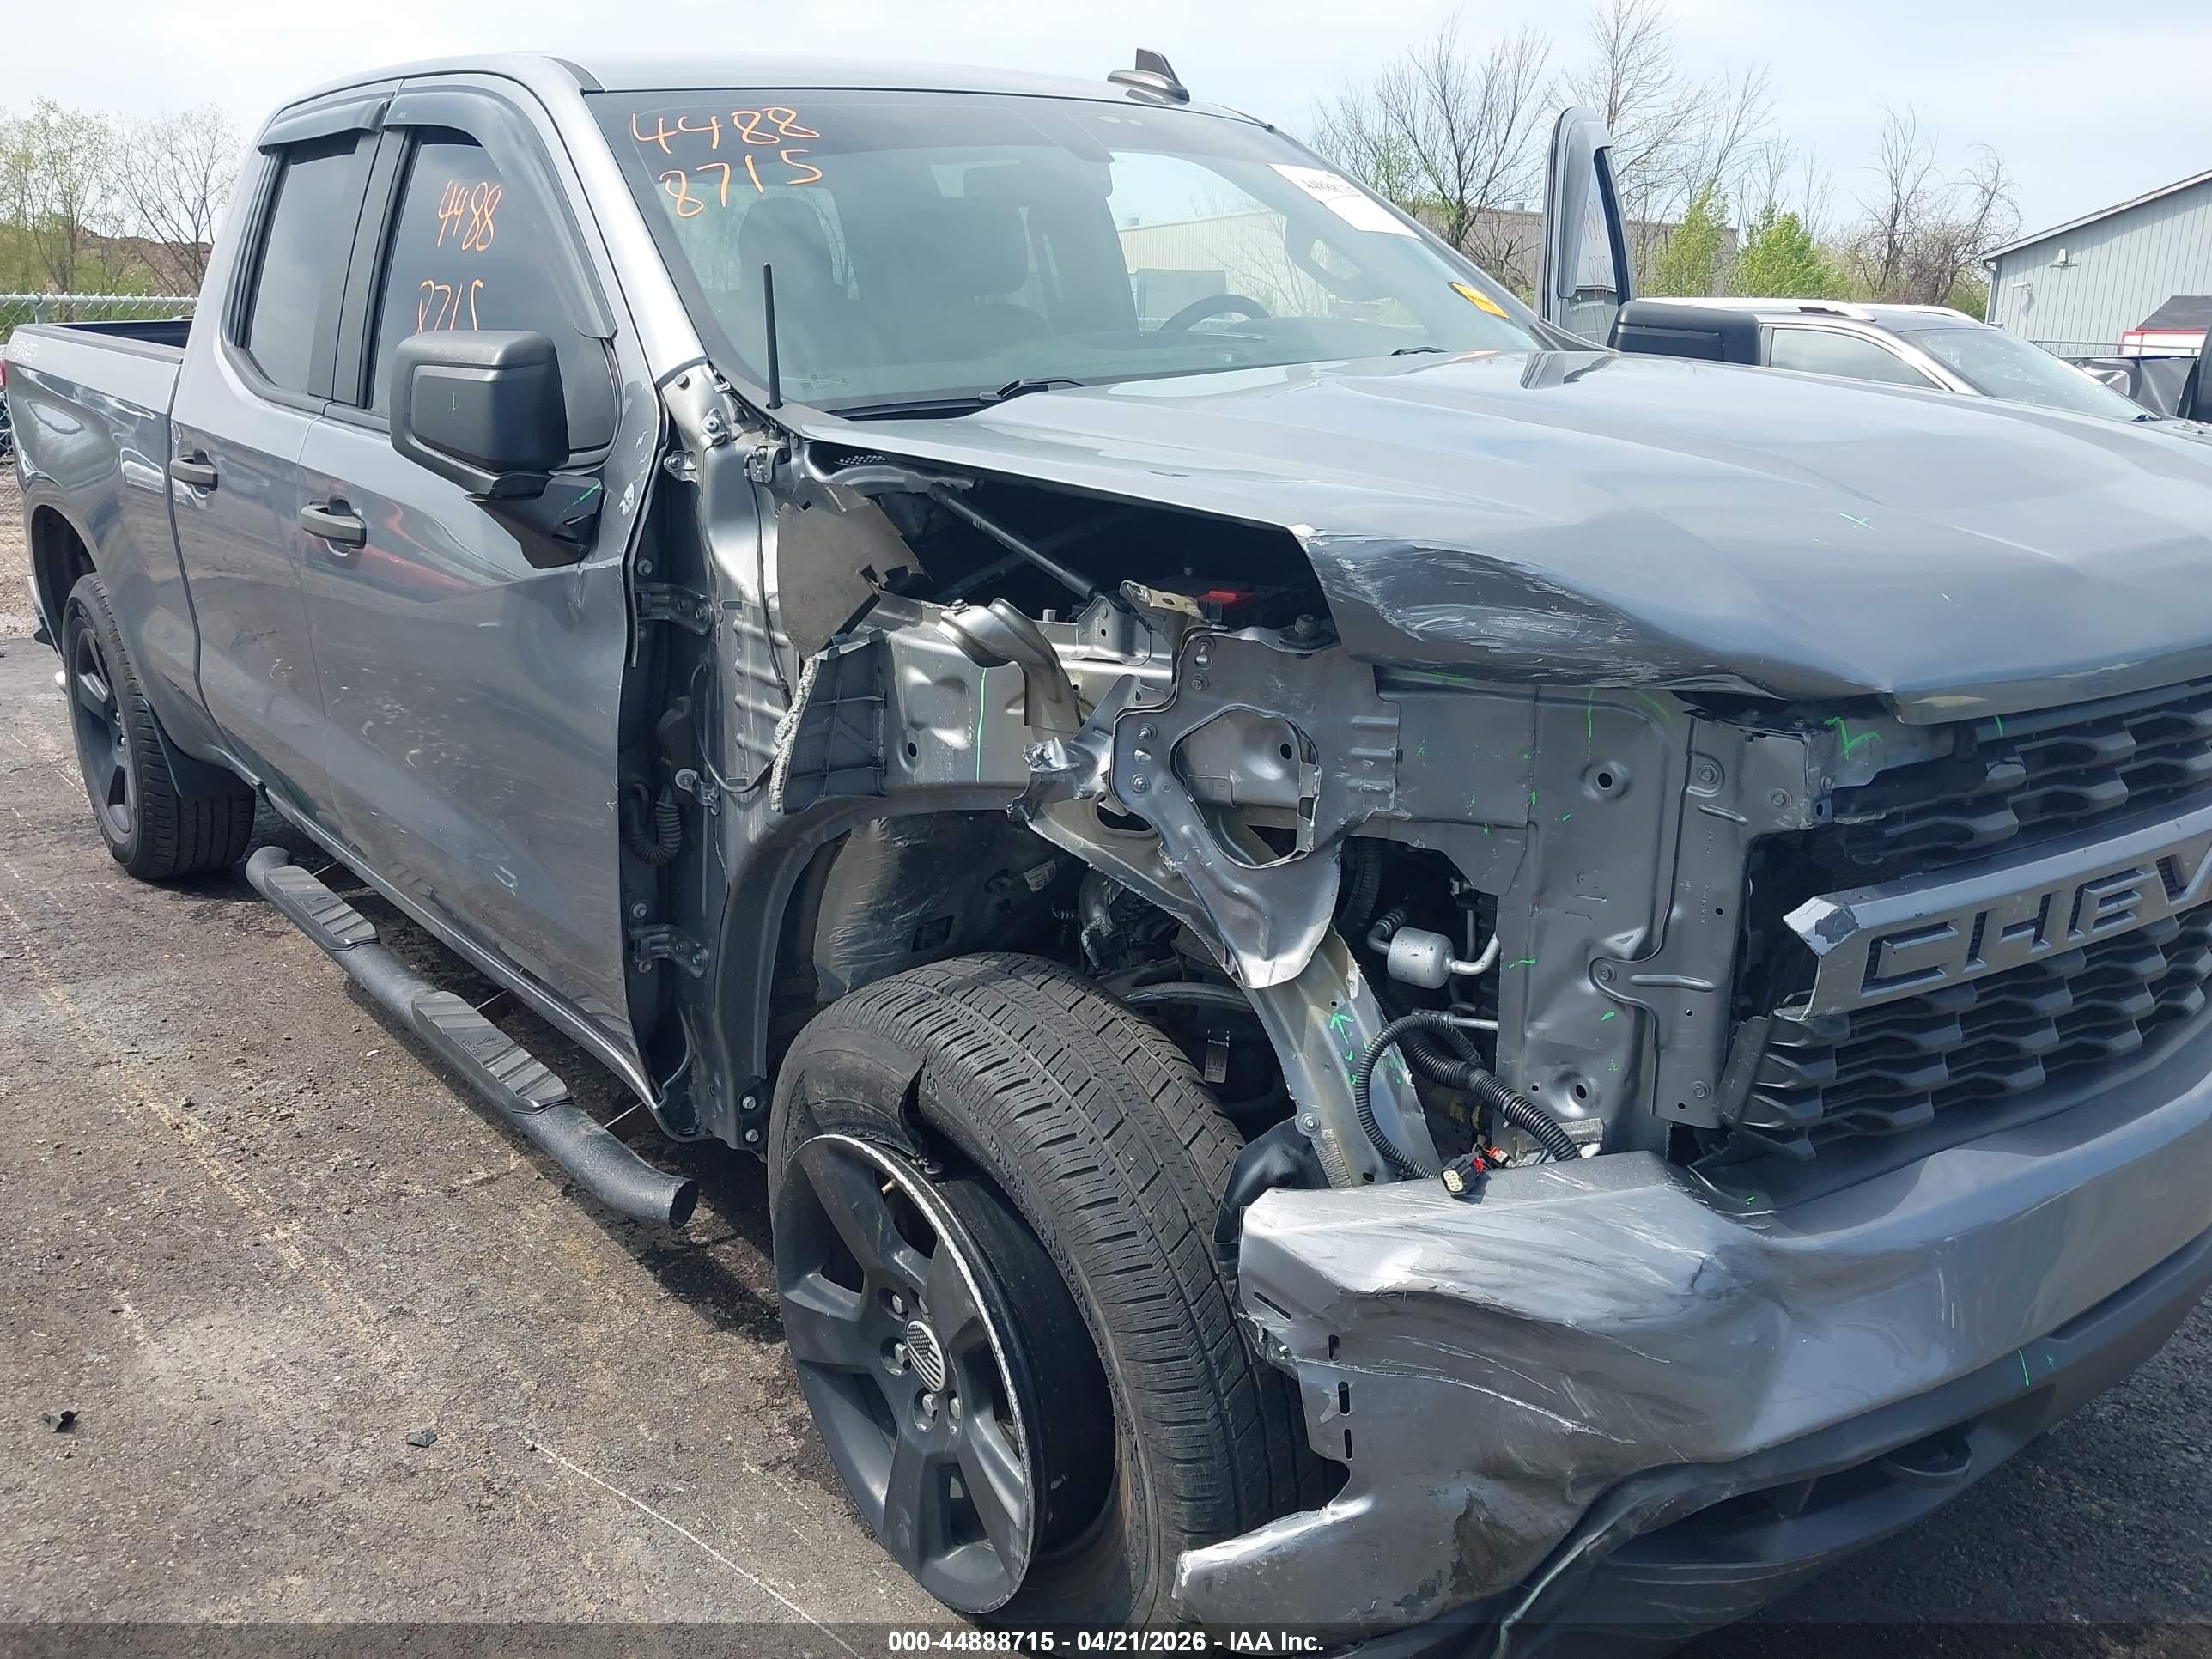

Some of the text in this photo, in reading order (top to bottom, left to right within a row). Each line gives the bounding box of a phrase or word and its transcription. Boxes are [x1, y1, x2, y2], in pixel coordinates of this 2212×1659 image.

[632, 106, 821, 155] 4488
[438, 179, 501, 252] 4488
[659, 149, 823, 217] 8715
